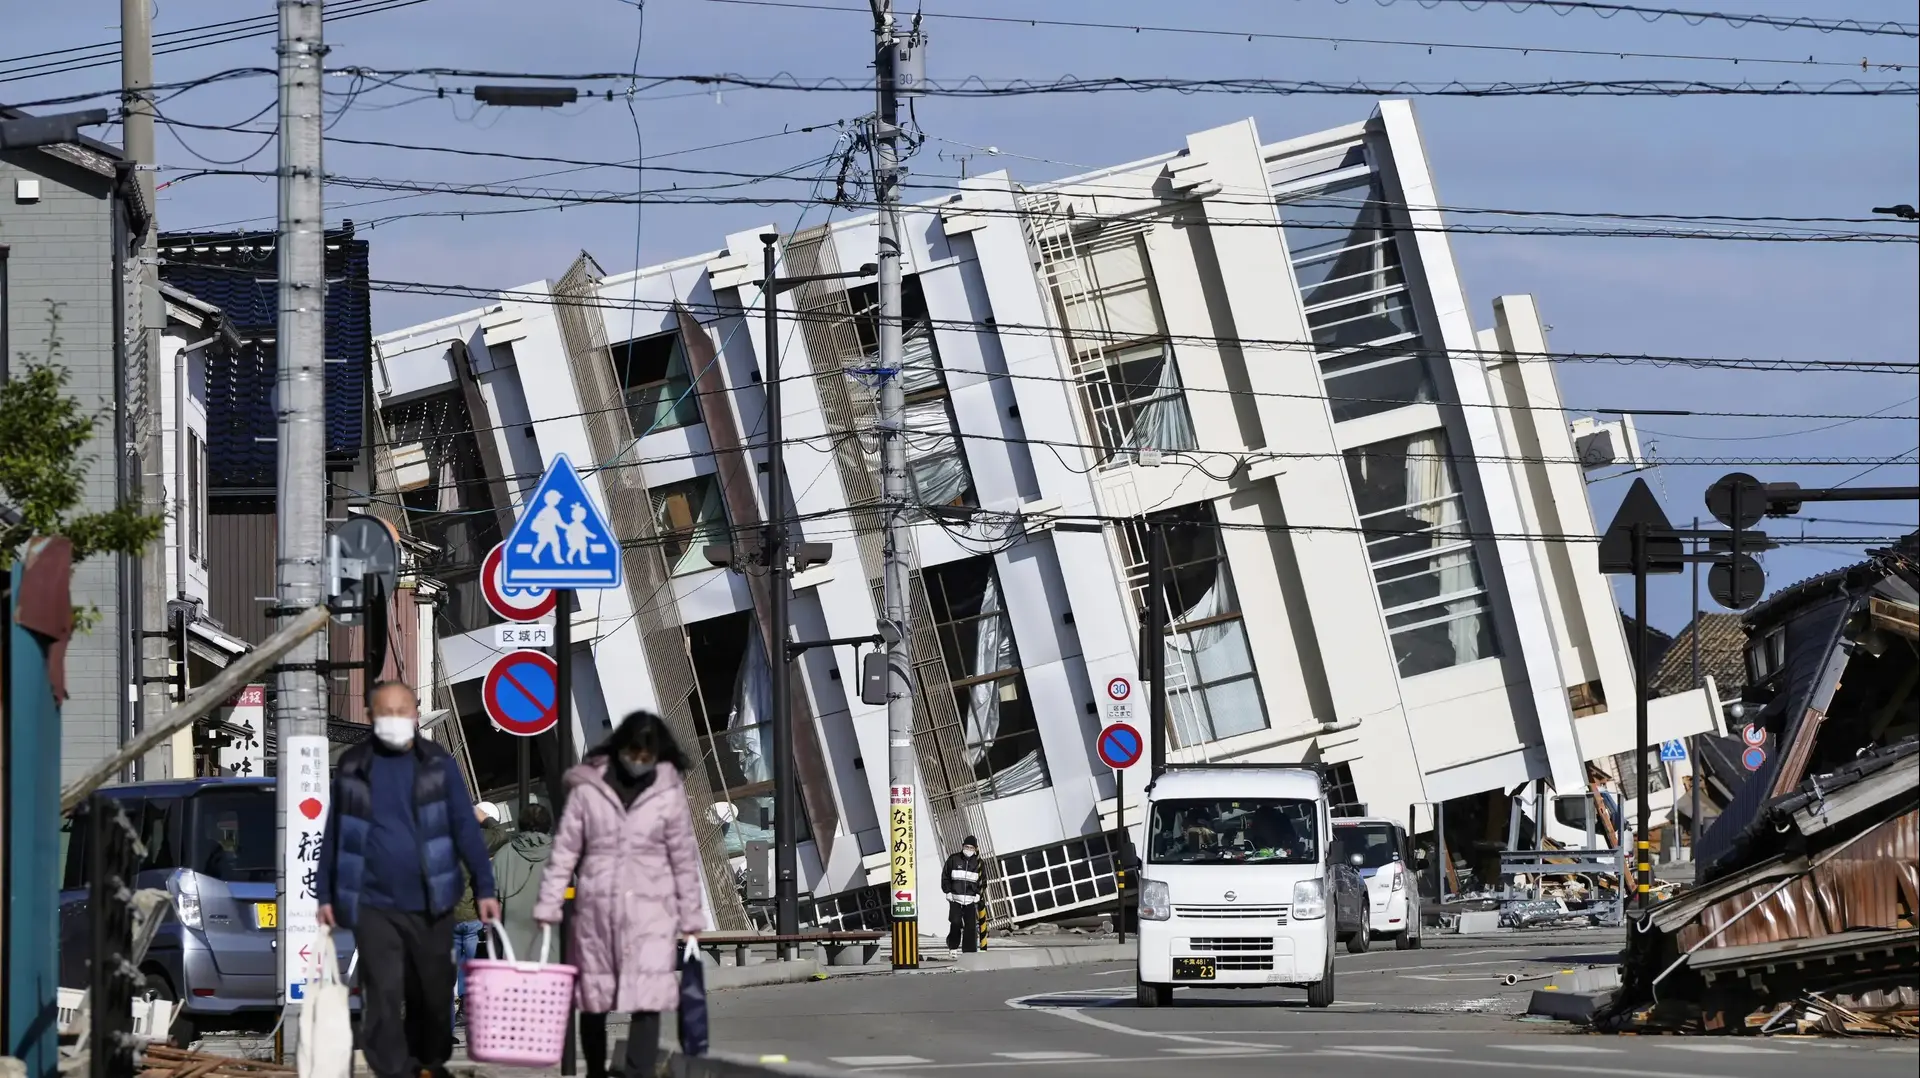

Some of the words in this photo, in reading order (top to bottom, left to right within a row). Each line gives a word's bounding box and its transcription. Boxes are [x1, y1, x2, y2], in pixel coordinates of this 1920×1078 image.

[503, 630, 546, 642] 区域内
[1113, 684, 1126, 694] 30
[891, 787, 911, 796] 無料
[893, 808, 908, 886] なつめの店
